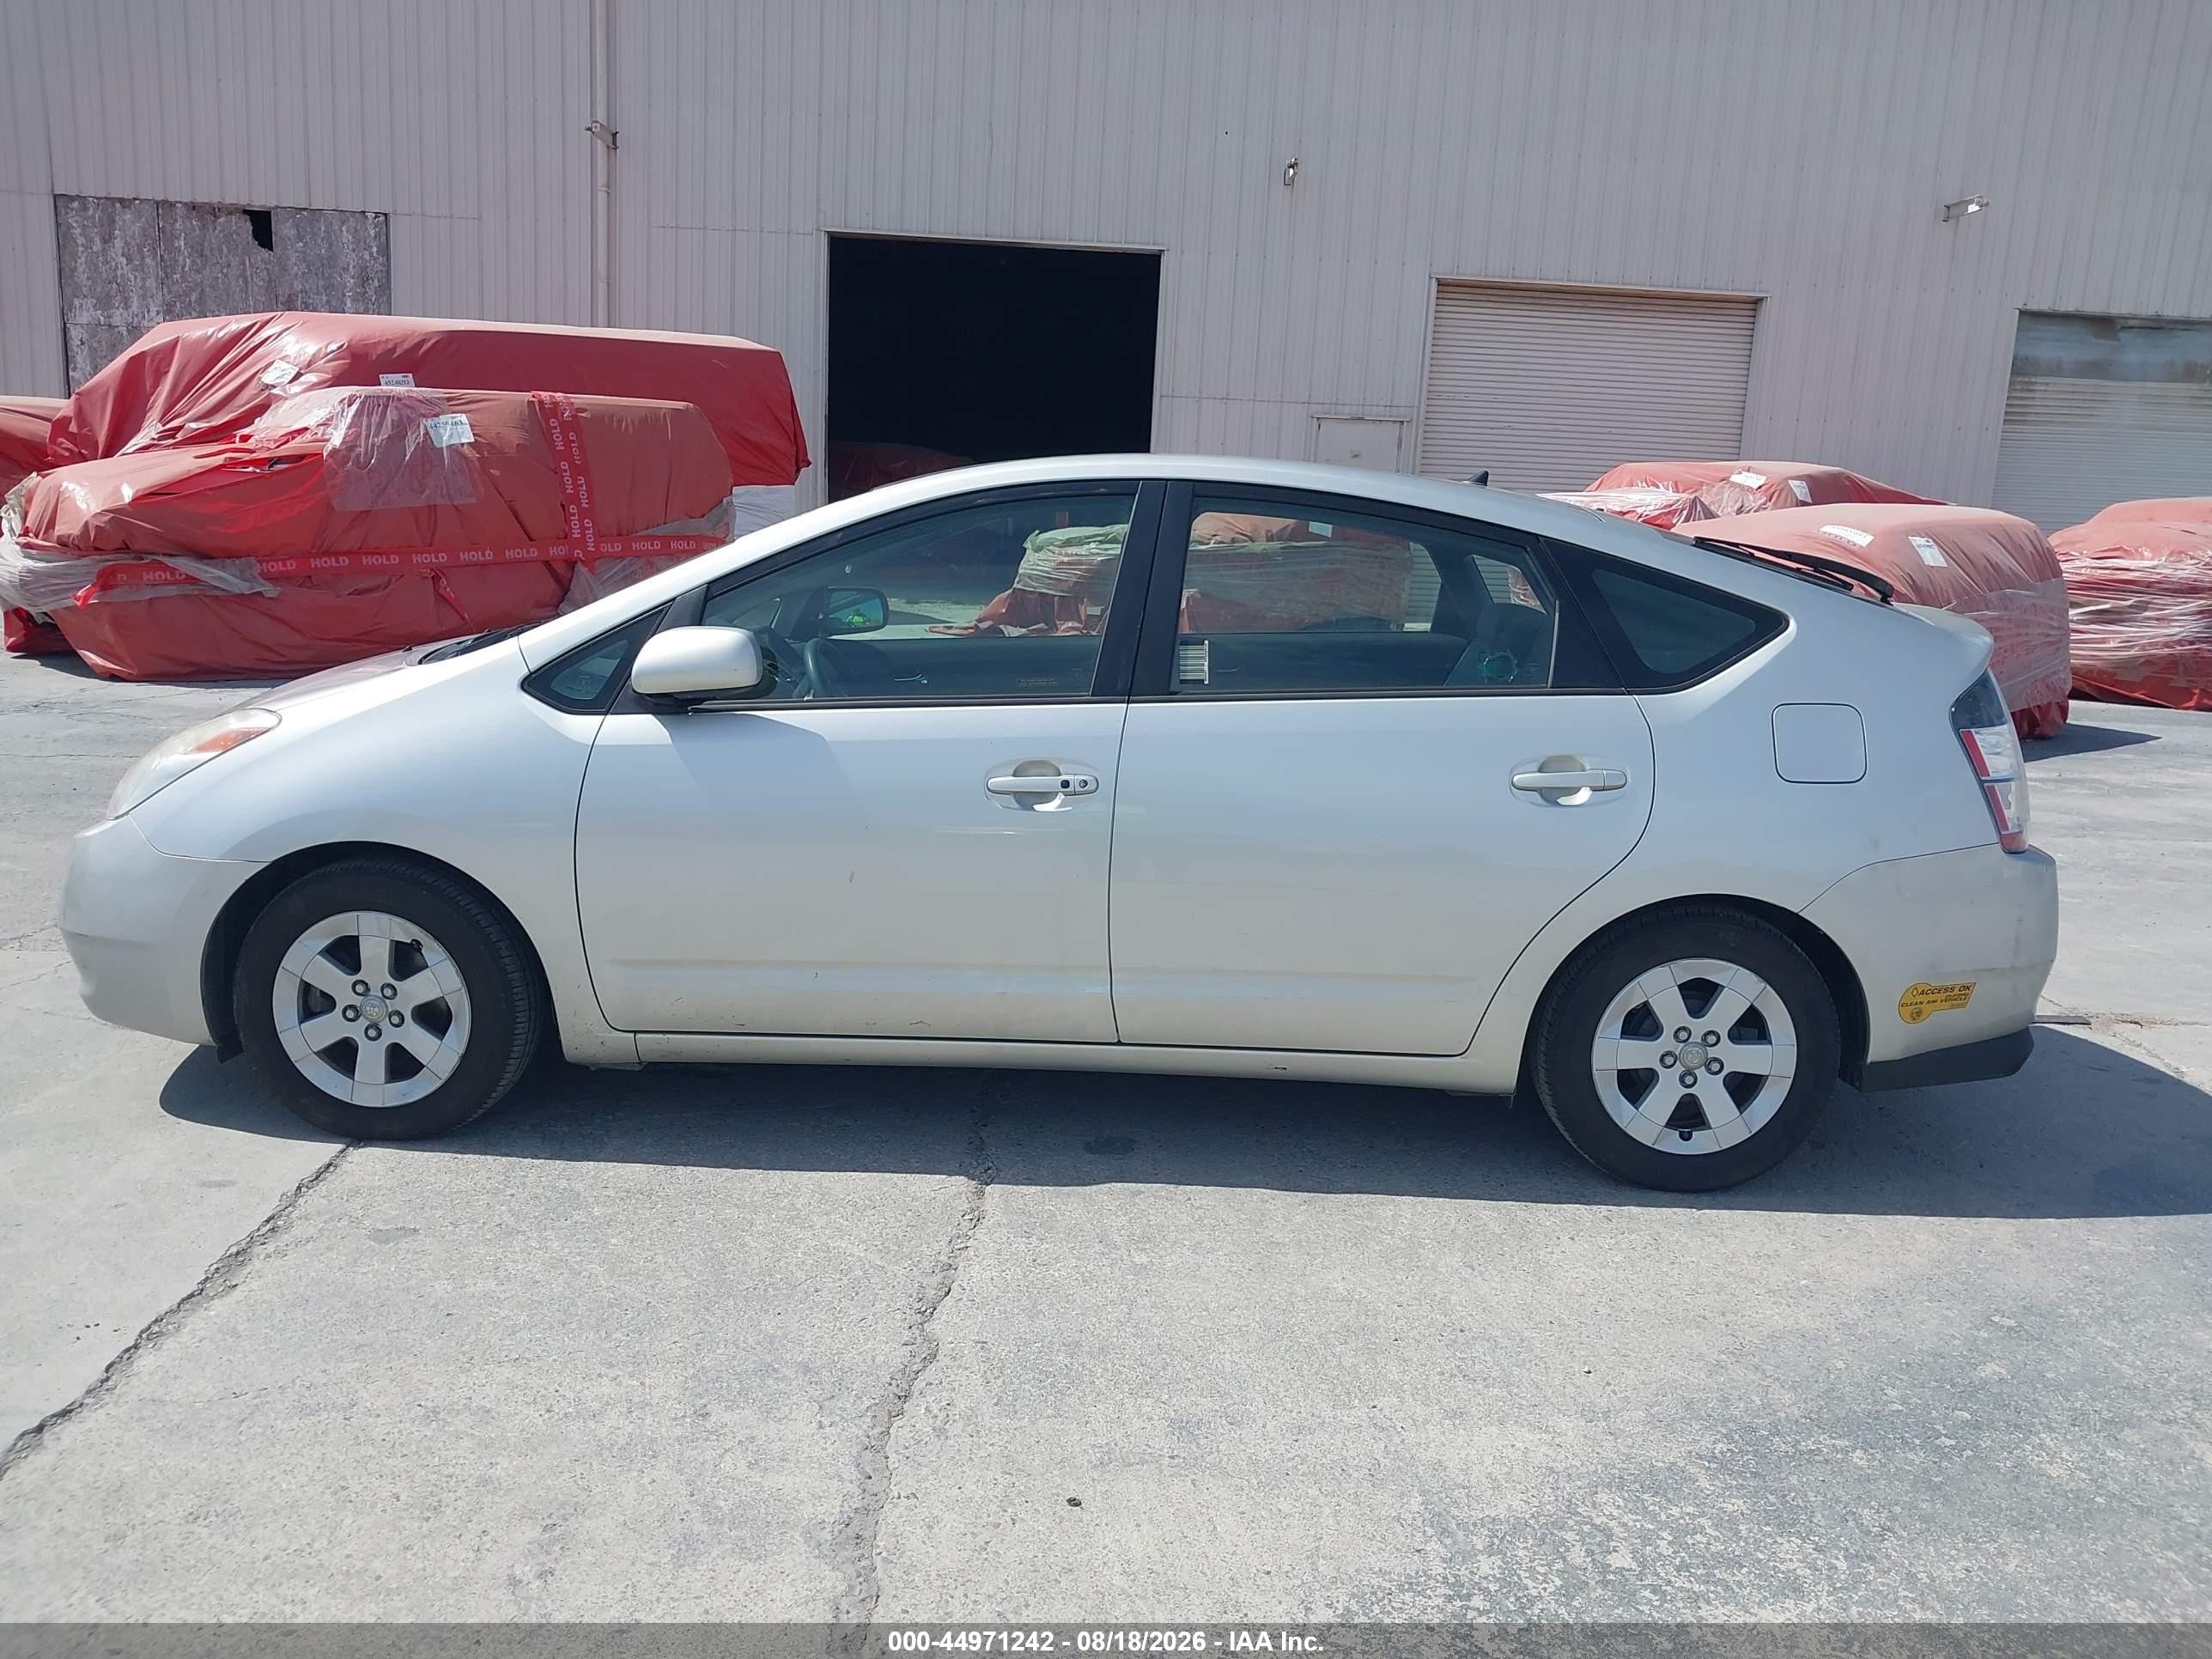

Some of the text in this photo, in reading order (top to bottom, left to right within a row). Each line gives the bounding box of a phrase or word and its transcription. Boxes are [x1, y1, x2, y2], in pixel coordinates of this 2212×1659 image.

[550, 418, 564, 450] HOLD
[560, 461, 574, 494] HOLD
[577, 476, 588, 508] HOLD
[569, 505, 580, 538] HOLD
[584, 519, 595, 551] HOLD
[143, 570, 186, 581] HOLD
[259, 560, 296, 573] HOLD
[311, 556, 349, 568] HOLD
[362, 555, 399, 565] HOLD
[412, 553, 447, 564] HOLD
[460, 550, 494, 562] HOLD
[505, 548, 538, 559] HOLD
[550, 545, 568, 556] HO
[600, 542, 622, 552] OLD
[632, 541, 661, 550] HOLD
[671, 540, 696, 550] HOLD
[1918, 986, 1956, 996] ACCESS
